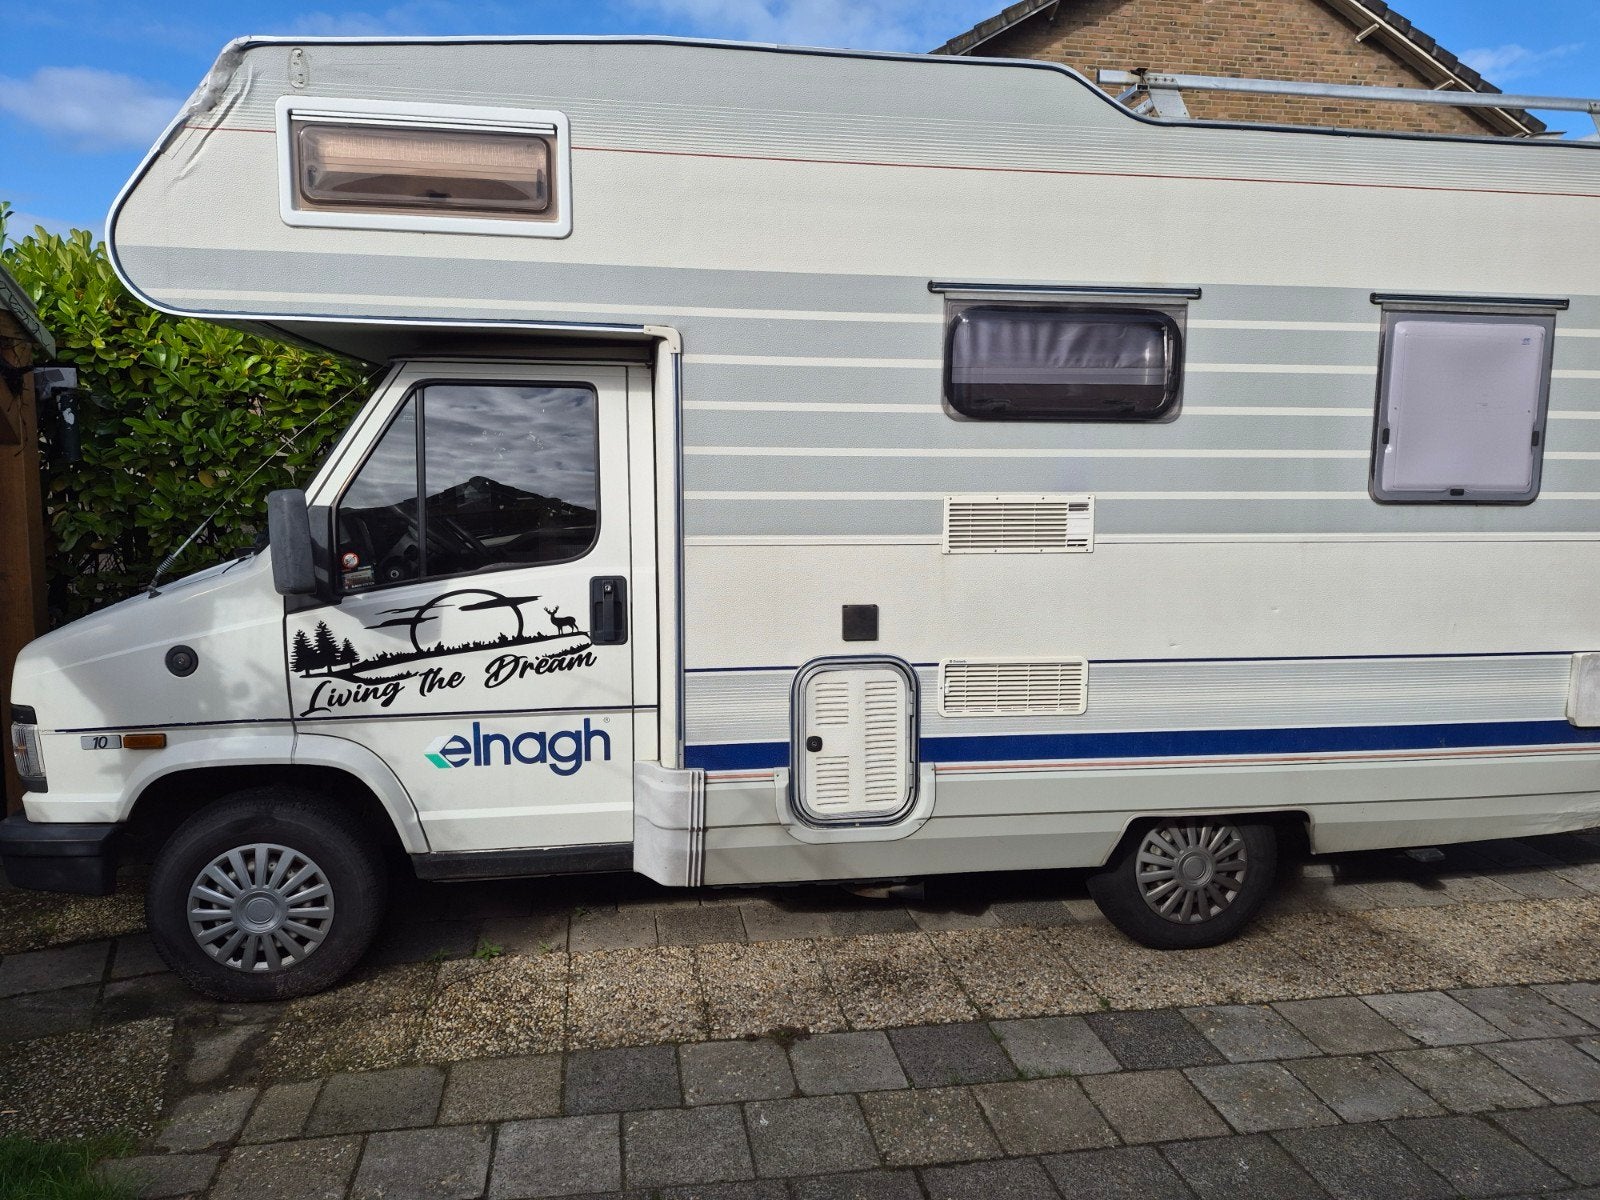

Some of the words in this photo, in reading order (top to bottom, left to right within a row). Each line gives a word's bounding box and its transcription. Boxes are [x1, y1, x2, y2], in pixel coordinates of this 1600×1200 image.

[300, 680, 405, 717] Living
[484, 652, 597, 688] Dream
[93, 736, 108, 749] 10
[439, 718, 611, 776] elnagh
